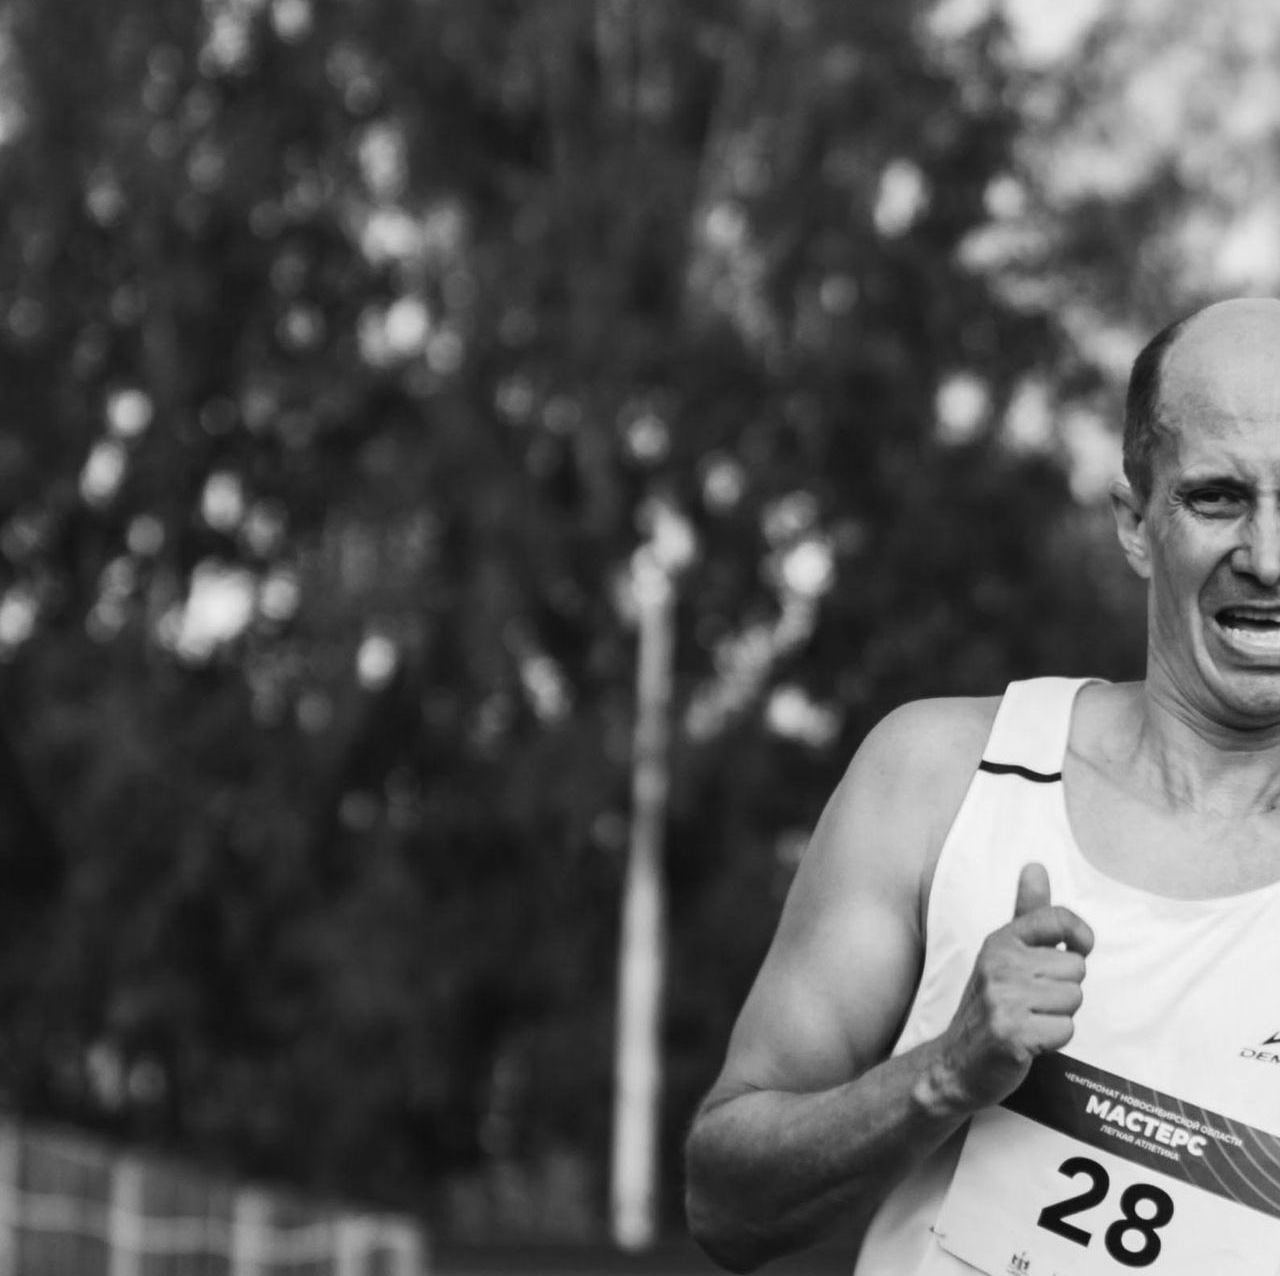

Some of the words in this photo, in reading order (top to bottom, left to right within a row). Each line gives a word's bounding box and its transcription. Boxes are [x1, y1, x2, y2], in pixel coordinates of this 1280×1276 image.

[1064, 1071, 1120, 1099] ЧЕМПИОНАТ
[1120, 1093, 1200, 1131] НОВОСИБИРСКОЙ
[1200, 1125, 1243, 1147] ОБЛАСТИ
[1085, 1094, 1207, 1157] МАСТЕРС
[1099, 1125, 1134, 1144] ЛЕГКАЯ
[1134, 1138, 1180, 1161] АТЛЕТИКА
[1037, 1156, 1174, 1268] 28
